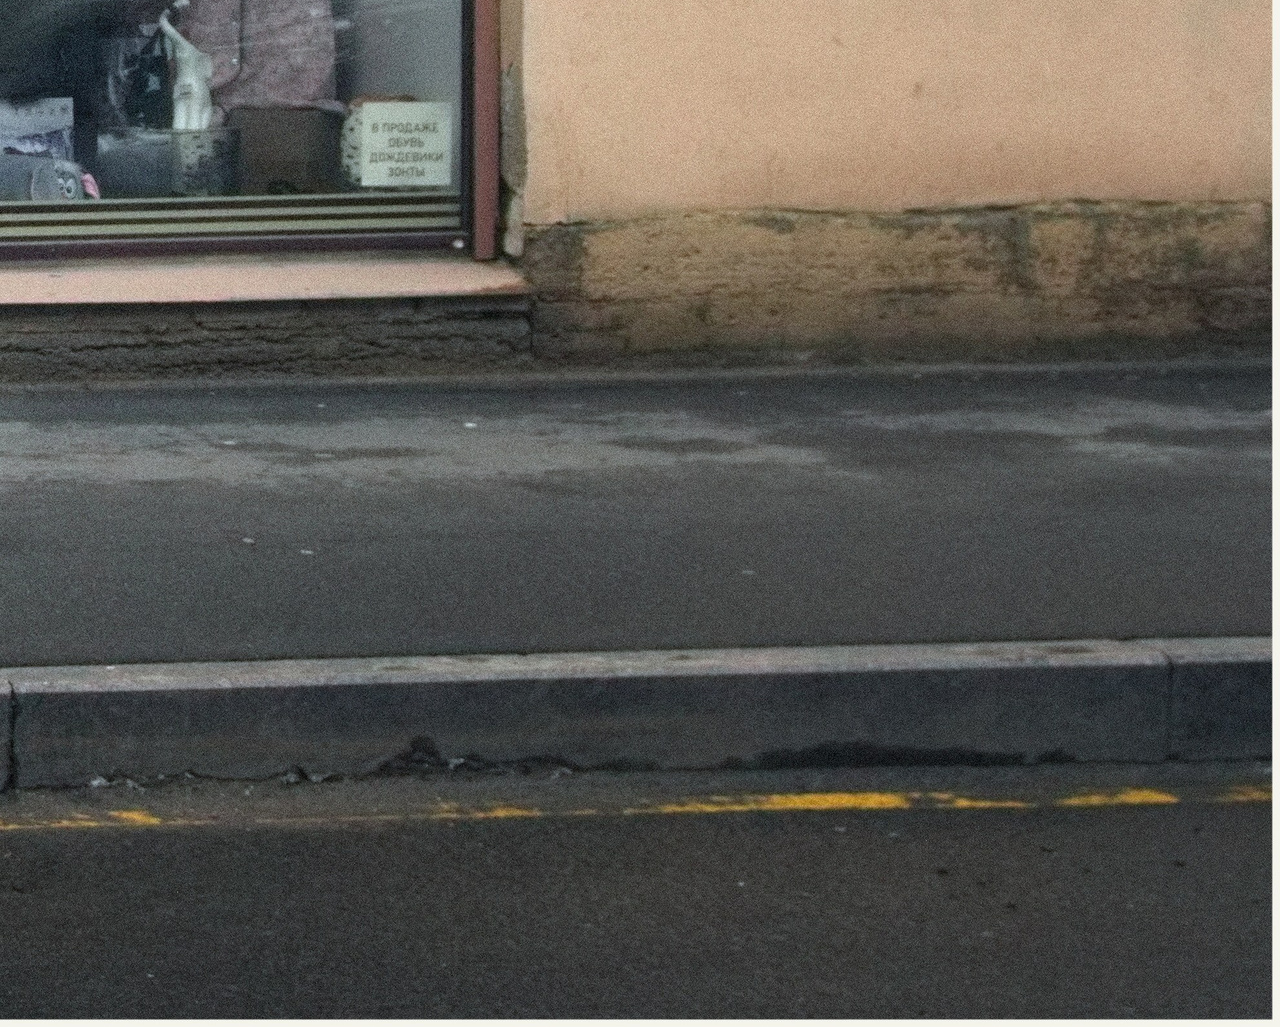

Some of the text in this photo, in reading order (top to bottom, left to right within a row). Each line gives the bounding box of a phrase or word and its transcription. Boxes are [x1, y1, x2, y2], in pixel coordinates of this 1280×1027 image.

[388, 137, 425, 148] ОБУВЬ
[369, 151, 444, 164] ДОЖДЕВИКИ
[388, 167, 425, 177] ЗОНТЫ
